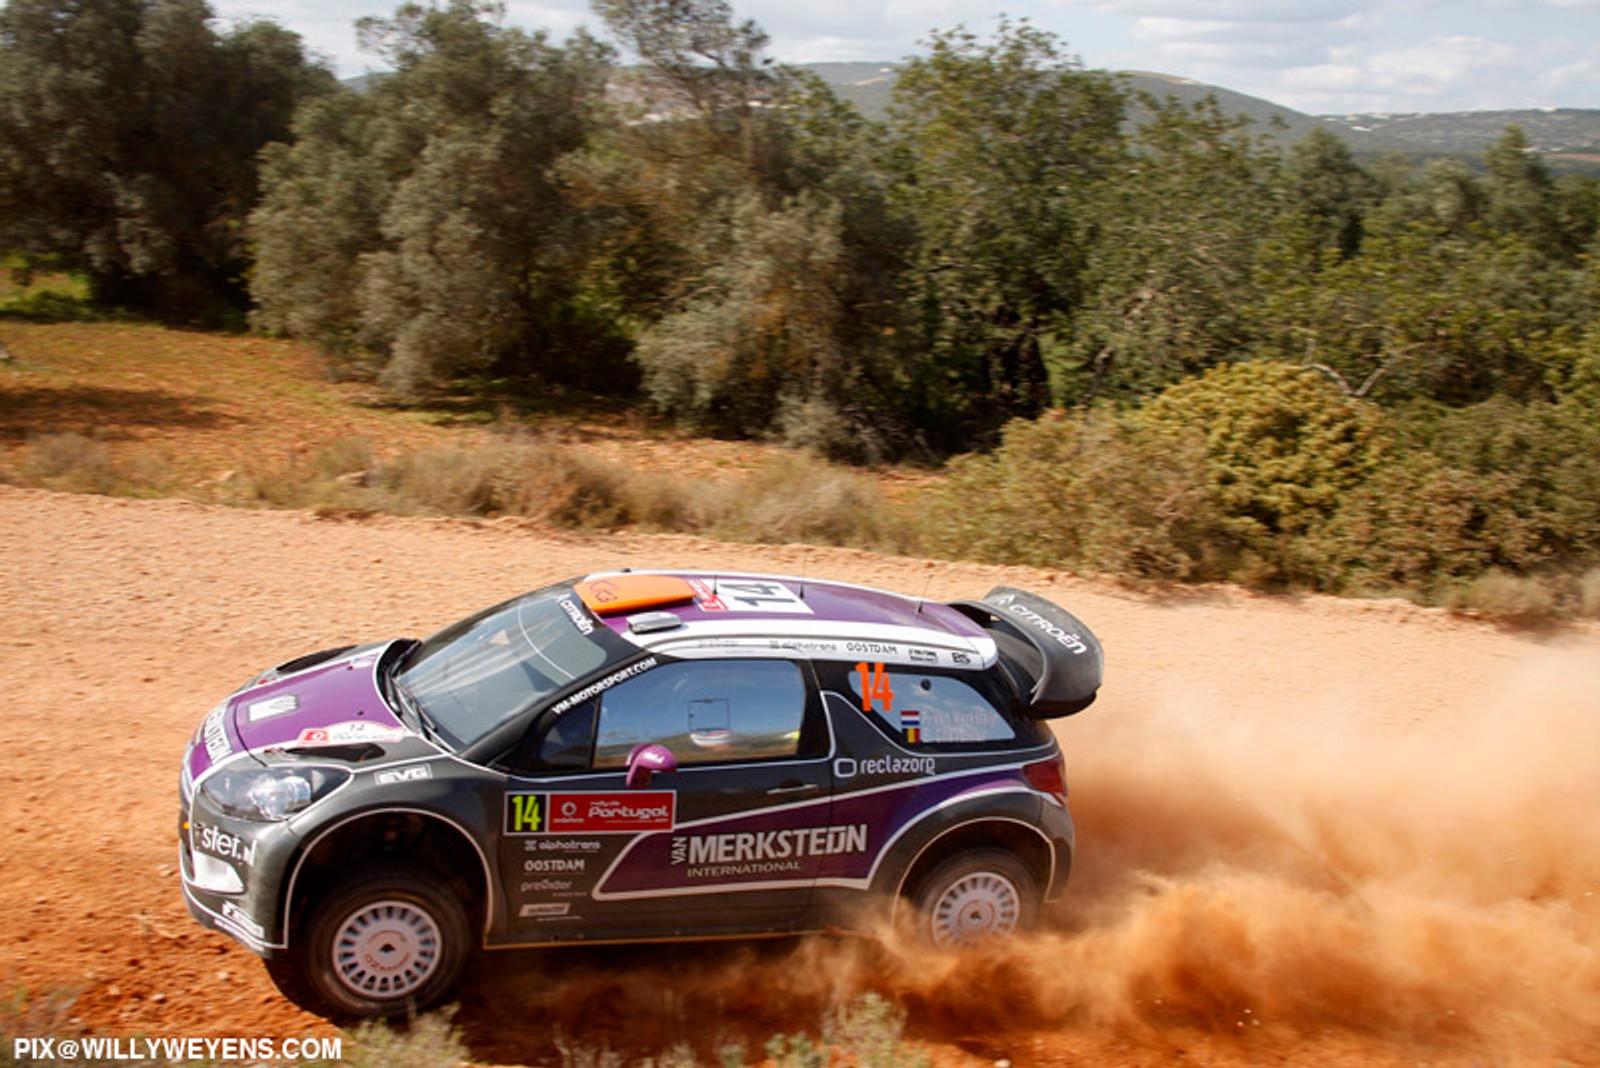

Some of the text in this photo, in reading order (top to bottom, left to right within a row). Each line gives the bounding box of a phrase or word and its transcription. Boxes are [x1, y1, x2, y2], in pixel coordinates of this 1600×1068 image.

[719, 583, 797, 607] 14
[845, 641, 898, 655] OOSTDAM
[551, 657, 658, 715] VM-MOTORSPORT.COM
[854, 661, 895, 712] 14
[860, 754, 937, 776] reclazorg
[511, 794, 542, 832] 14
[587, 804, 669, 820] Portugal
[670, 836, 688, 865] VAN
[524, 859, 586, 872] OOSTDAM
[686, 861, 802, 878] INTERNATIONAL
